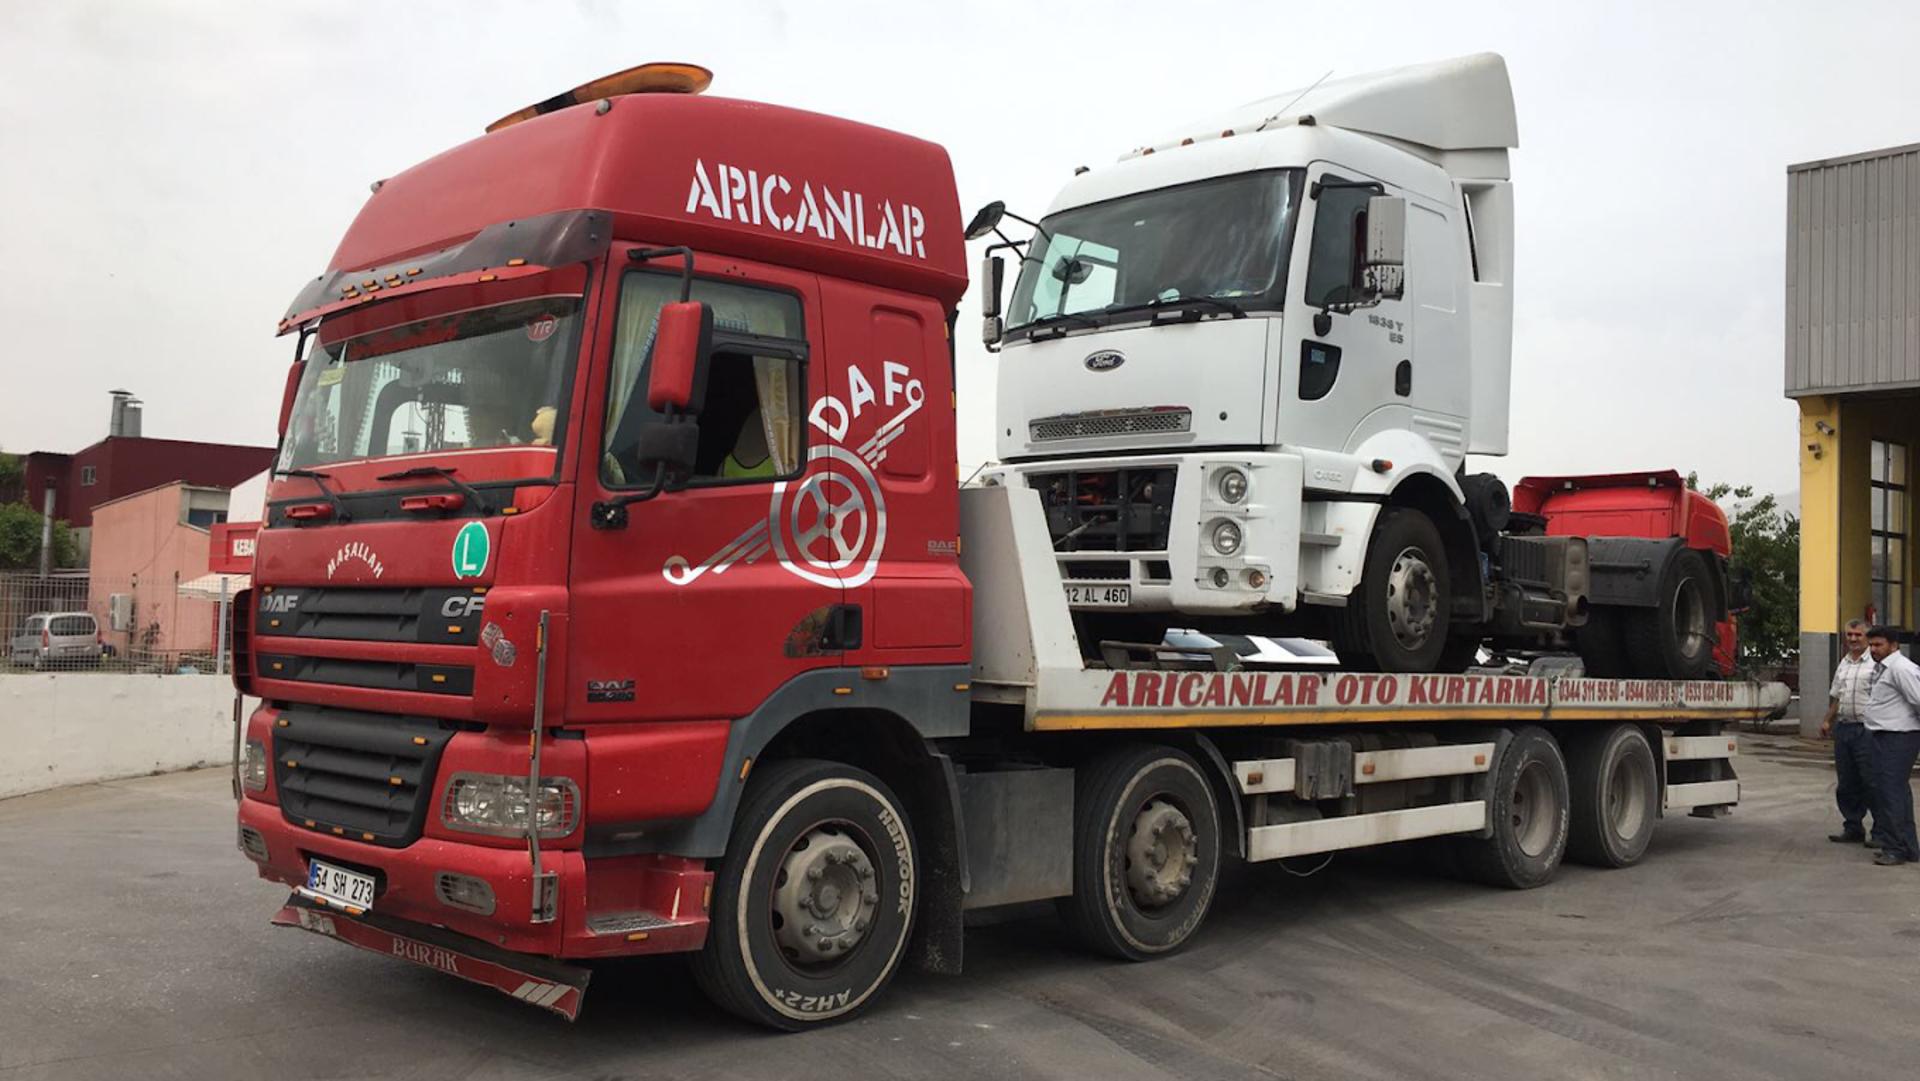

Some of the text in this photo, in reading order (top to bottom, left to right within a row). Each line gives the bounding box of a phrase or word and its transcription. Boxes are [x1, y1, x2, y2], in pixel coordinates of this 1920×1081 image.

[685, 158, 927, 260] ARICANLAR
[808, 360, 910, 444] DAF
[461, 532, 477, 571] L
[260, 595, 298, 613] DAF
[440, 596, 485, 618] CF
[1065, 587, 1128, 603] 12 AL 460
[1101, 671, 1324, 707] ARICANLAR
[1334, 674, 1399, 706] OTO
[1407, 675, 1548, 706] KURTARMA
[315, 866, 373, 905] 54 SH 273
[392, 936, 459, 973] BURAK
